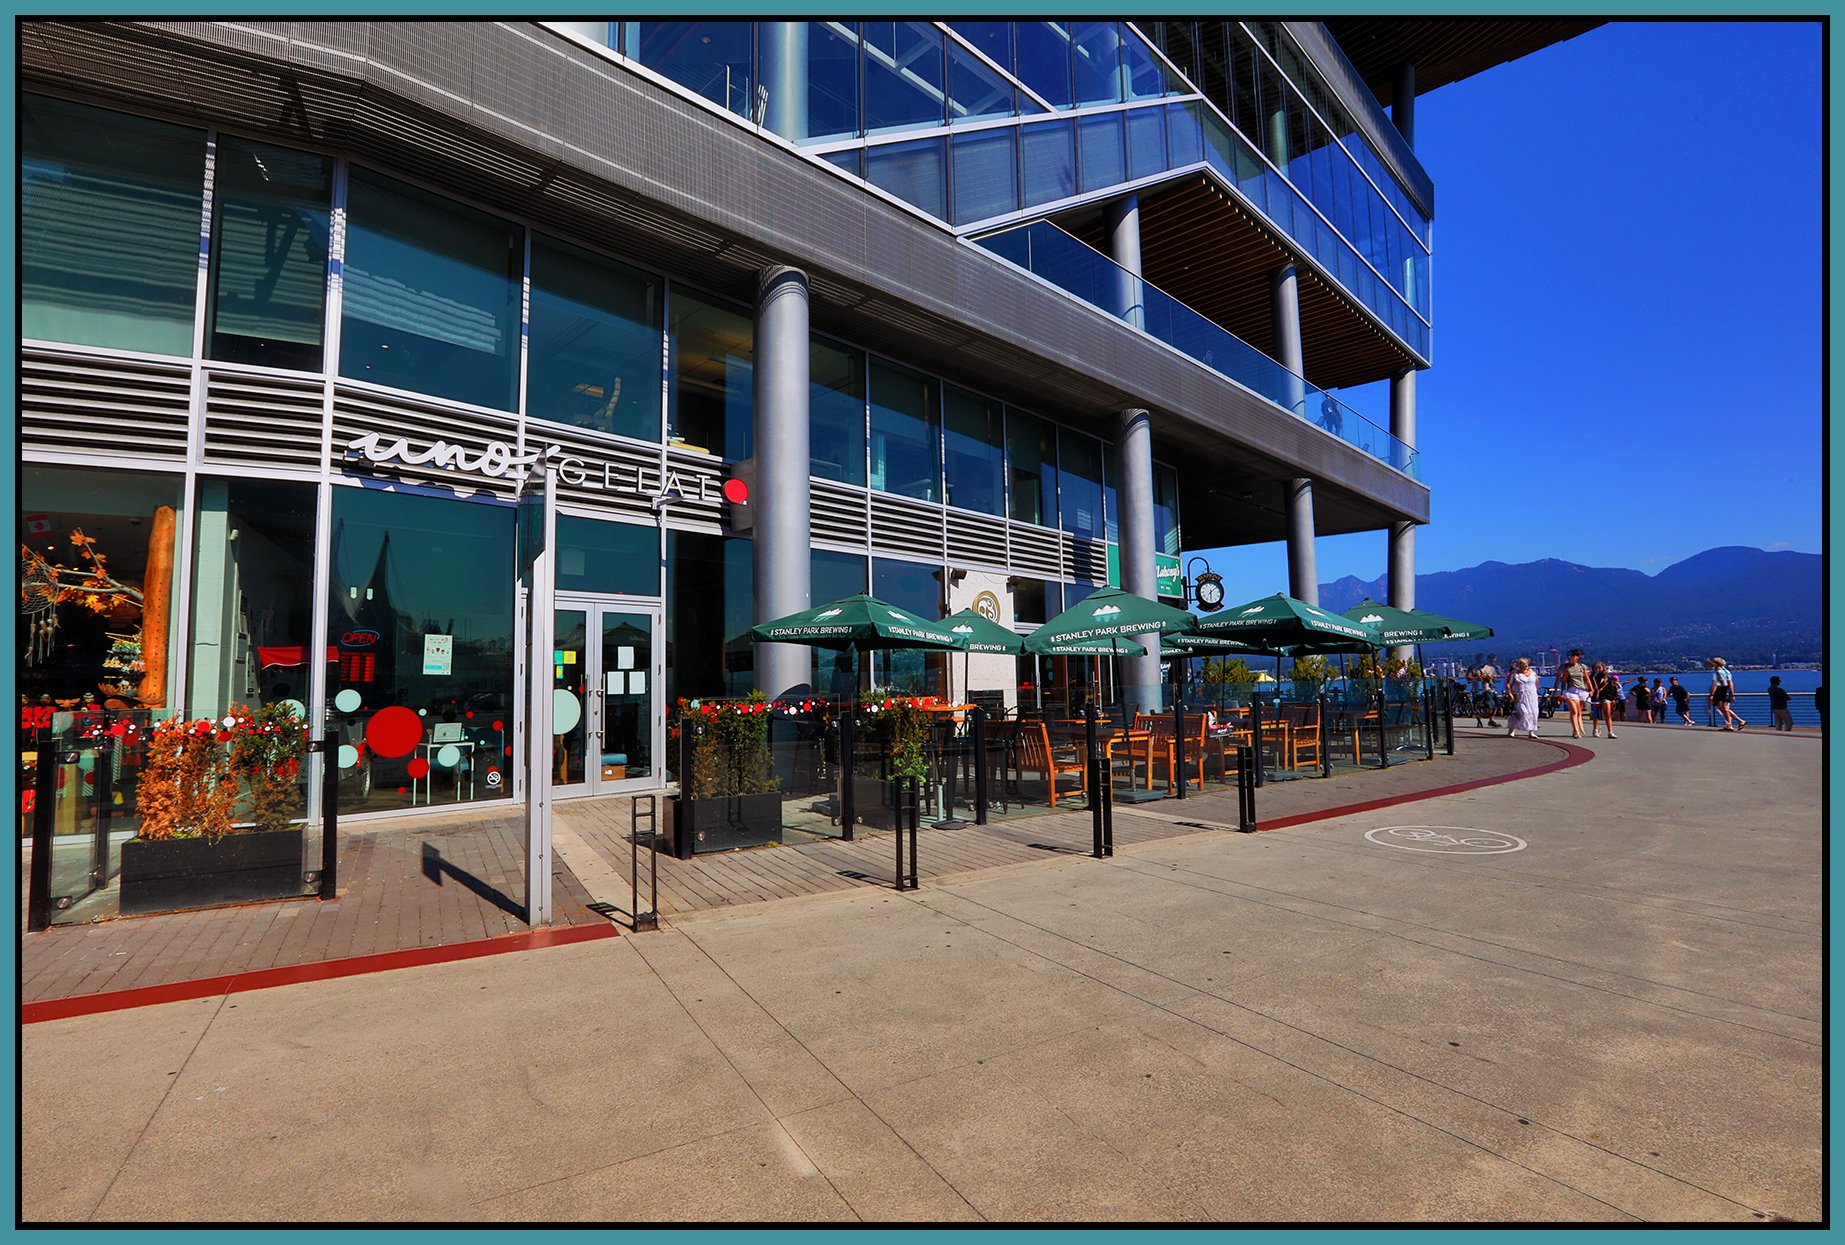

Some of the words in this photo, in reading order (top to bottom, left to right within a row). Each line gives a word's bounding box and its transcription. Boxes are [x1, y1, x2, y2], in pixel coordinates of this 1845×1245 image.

[348, 432, 561, 478] uno
[774, 627, 802, 635] STANLEY
[803, 626, 819, 634] PARK
[820, 626, 849, 634] BREWING
[1056, 630, 1095, 642] STANLEY
[1096, 626, 1118, 635] PARK
[1120, 622, 1162, 633] BREWING
[1203, 622, 1228, 630] STANLEY
[1314, 620, 1332, 629] STANLEY
[1332, 624, 1343, 632] PARK
[1343, 627, 1364, 637] BREWING
[342, 632, 377, 644] OPEN
[891, 627, 913, 636] STANLEY
[912, 629, 925, 638] PARK
[926, 632, 950, 642] BREWING
[969, 643, 1002, 651] BREWING
